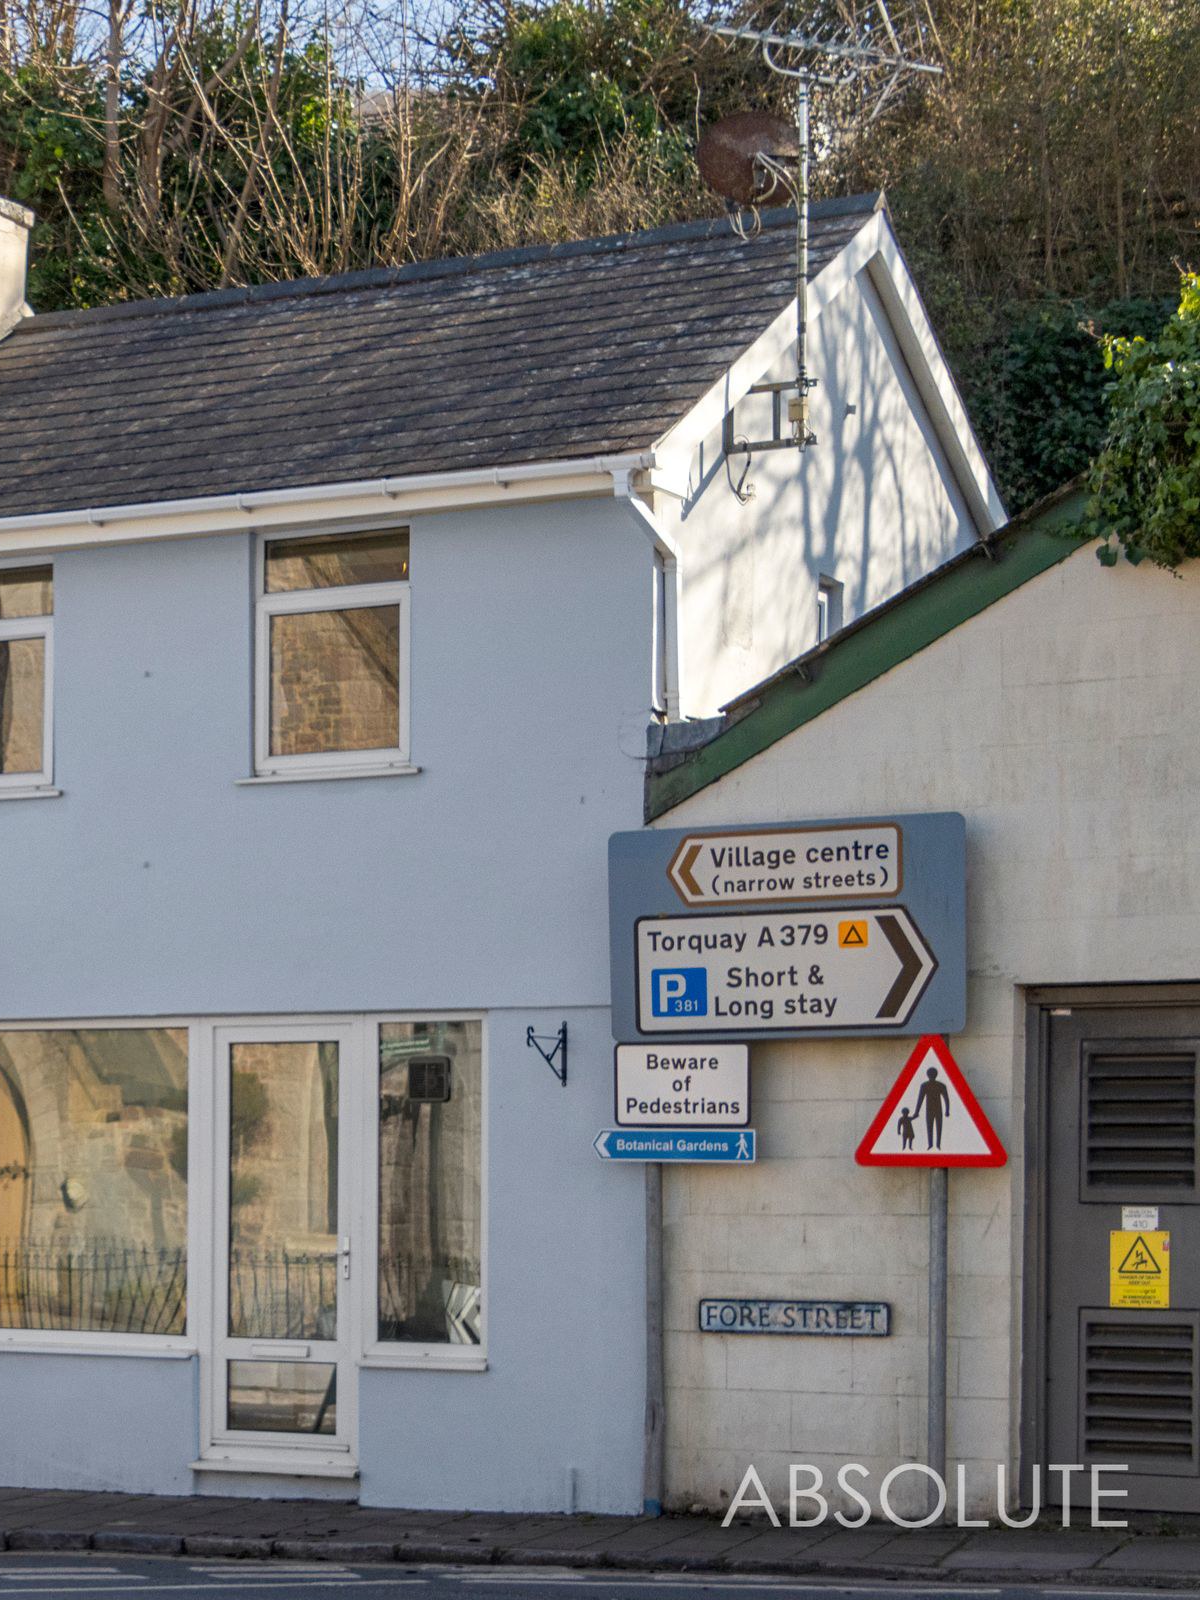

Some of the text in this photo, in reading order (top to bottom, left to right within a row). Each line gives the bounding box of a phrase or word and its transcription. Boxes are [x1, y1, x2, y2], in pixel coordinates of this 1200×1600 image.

[710, 840, 889, 872] Village centre
[712, 865, 890, 895] (narrow streets)
[647, 929, 747, 954] Torquay
[726, 964, 825, 988] Short &
[659, 973, 687, 1013] P
[674, 1000, 699, 1013] 381
[714, 994, 838, 1019] Long stay
[646, 1054, 719, 1071] Beware
[672, 1075, 692, 1093] of
[626, 1098, 740, 1115] Pedestrians
[616, 1138, 728, 1152] Botanical Gardens
[706, 1306, 881, 1330] FORE STREET
